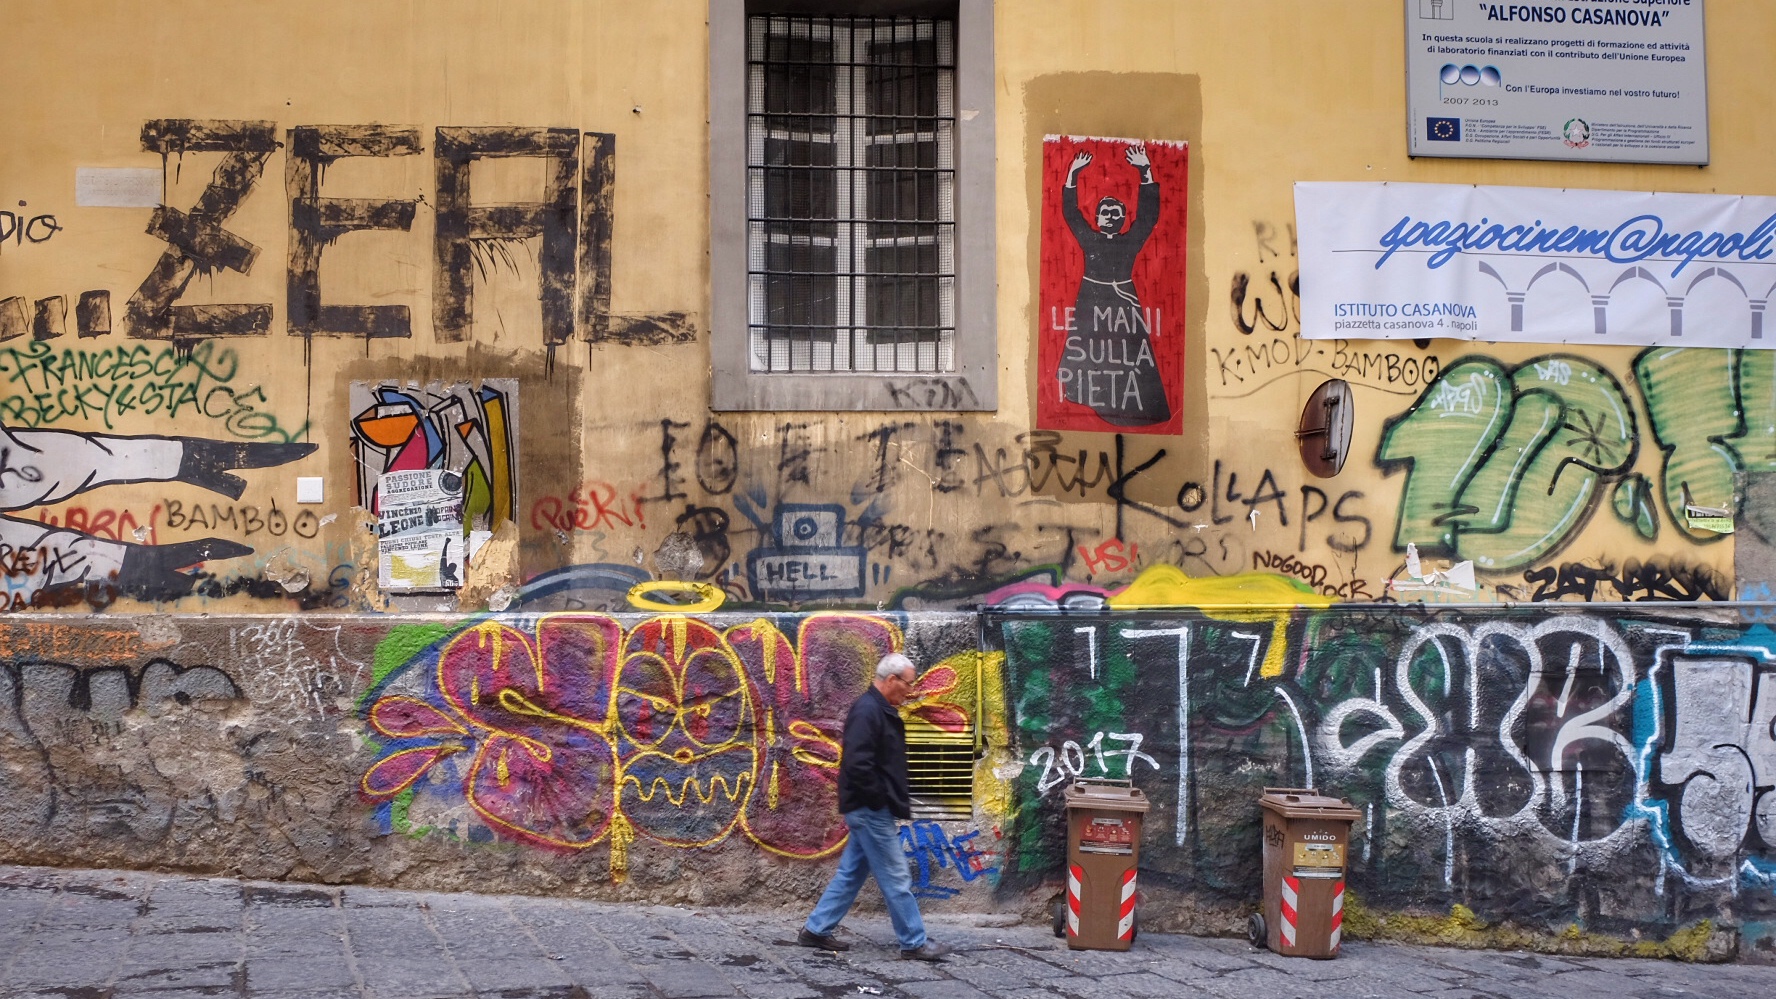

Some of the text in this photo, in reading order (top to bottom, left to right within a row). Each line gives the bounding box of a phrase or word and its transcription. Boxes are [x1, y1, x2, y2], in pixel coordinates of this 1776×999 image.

[1422, 33, 1431, 41] In
[1434, 34, 1462, 43] questa
[1465, 35, 1493, 43] scuola
[1495, 36, 1502, 44] si
[1505, 37, 1548, 46] realizzano
[1551, 39, 1584, 48] progetti
[1597, 40, 1644, 49] formazione
[1646, 42, 1657, 50] ed
[1659, 42, 1690, 51] attività
[1427, 45, 1435, 53] di
[1437, 45, 1485, 55] laboratorio
[1487, 47, 1527, 56] finanziati
[1555, 50, 1599, 59] contributo
[1601, 52, 1649, 61] dell'Unione
[1651, 53, 1686, 63] Europea
[1505, 84, 1680, 98] Con l'Europa investiamo nel vostro futuro!
[1443, 97, 1498, 106] 2007 2013
[1334, 303, 1477, 319] ISTITUTO CASANOVA
[1052, 305, 1161, 336] LE MANI
[1334, 318, 1381, 331] piazzetta
[1383, 319, 1434, 330] casanova
[1436, 319, 1444, 328] 4
[1451, 319, 1478, 332] napoli
[1065, 336, 1154, 367] SULLA
[1056, 367, 1143, 411] PIETÀ
[385, 471, 432, 484] PASSIONE
[386, 478, 433, 490] SUDORE
[387, 485, 433, 494] AGGREGAZIONE
[165, 497, 319, 539] BAMBOO
[378, 515, 424, 539] LEONE
[766, 561, 837, 585] HELL
[1030, 731, 1161, 792] 2017
